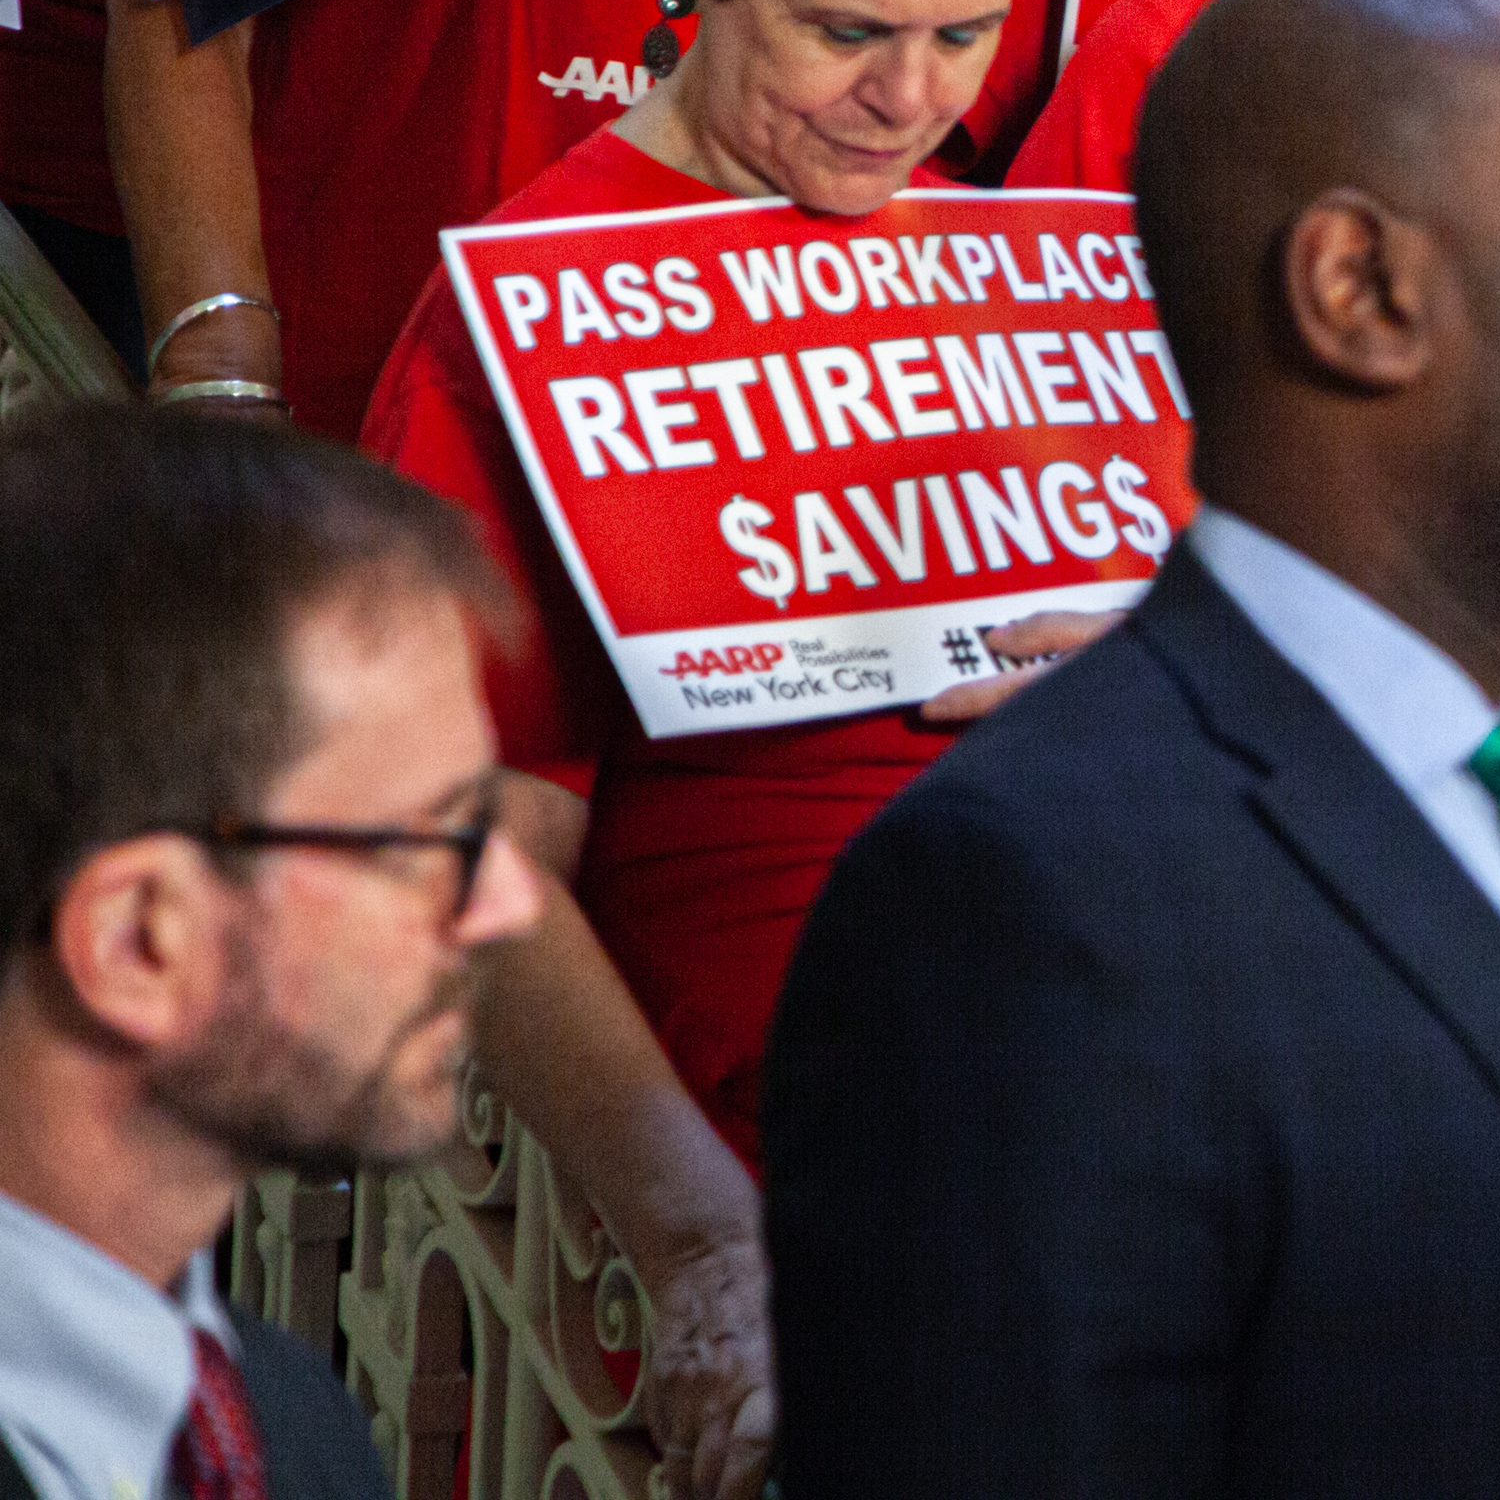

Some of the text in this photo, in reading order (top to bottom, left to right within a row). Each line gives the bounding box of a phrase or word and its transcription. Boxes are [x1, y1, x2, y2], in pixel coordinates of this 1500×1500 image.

[494, 256, 715, 351] PASS
[547, 329, 1193, 478] RETIREMENT
[717, 454, 1172, 609] $AVING$
[659, 638, 825, 680] AARP Real
[681, 663, 896, 711] New York City
[797, 645, 890, 669] Possibilities
